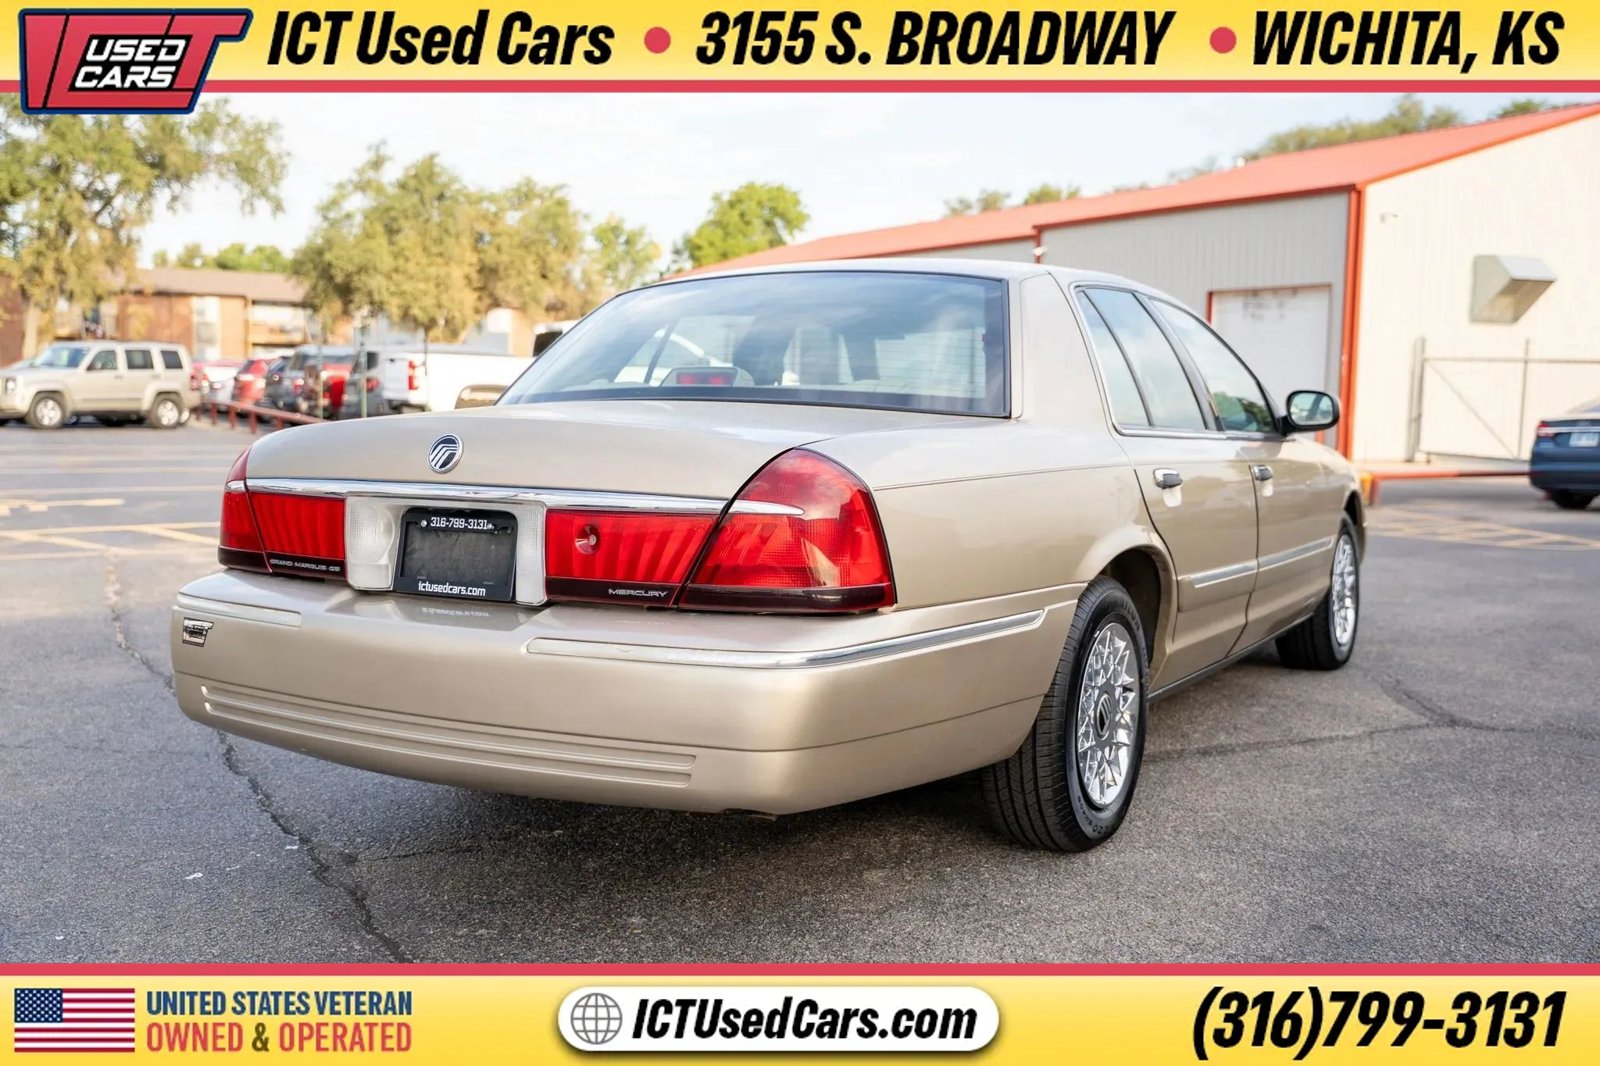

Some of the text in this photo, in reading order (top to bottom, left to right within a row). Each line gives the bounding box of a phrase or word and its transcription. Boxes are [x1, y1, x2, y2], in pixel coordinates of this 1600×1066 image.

[430, 516, 489, 530] 316-799-3131
[269, 558, 293, 568] GRAND
[294, 562, 327, 571] MARQUIS
[418, 580, 486, 597] ictusedcars.com
[608, 588, 669, 599] MERCURY
